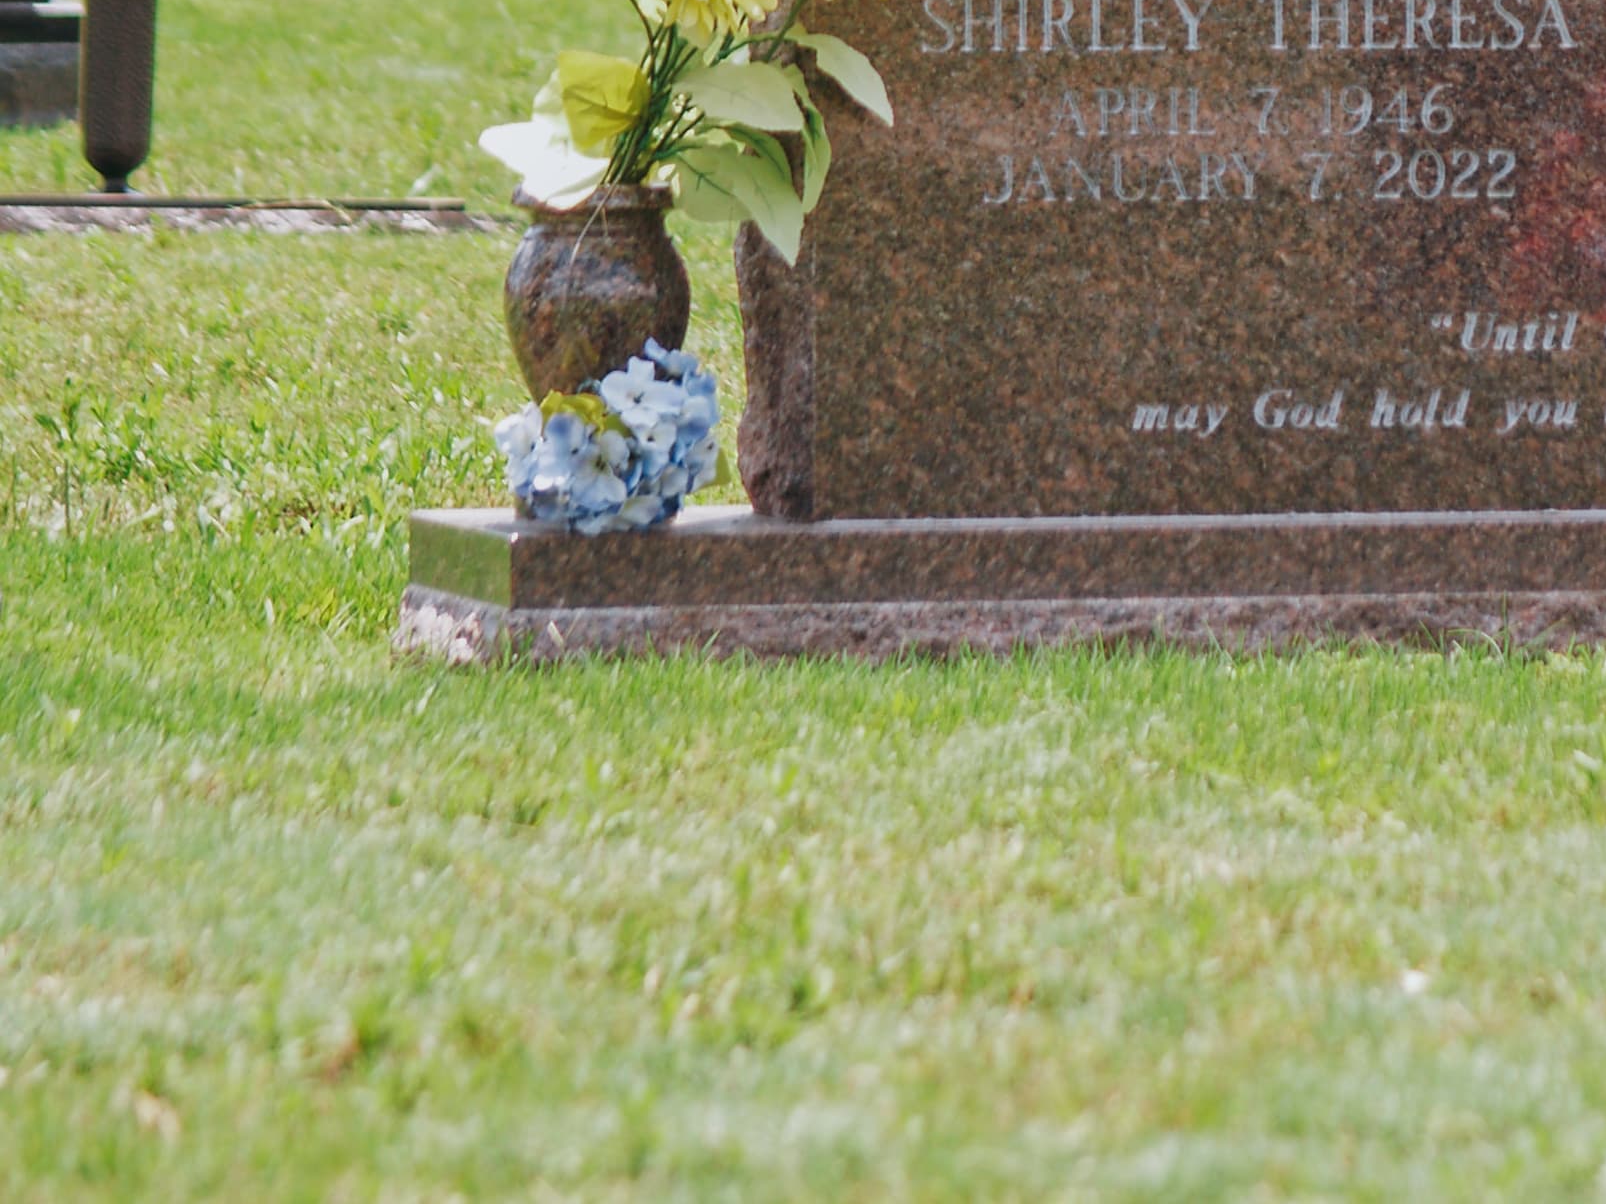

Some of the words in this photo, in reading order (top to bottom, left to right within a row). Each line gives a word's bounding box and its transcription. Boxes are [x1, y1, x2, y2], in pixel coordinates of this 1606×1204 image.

[1048, 86, 1216, 137] APRIL
[1311, 83, 1456, 137] 1946
[983, 152, 1267, 204] JANUARY
[1373, 149, 1518, 200] 2022
[1430, 312, 1578, 353] “Until
[1131, 402, 1230, 437] may
[1252, 388, 1347, 430] God
[1369, 387, 1474, 430] hold
[1495, 397, 1581, 435] you
